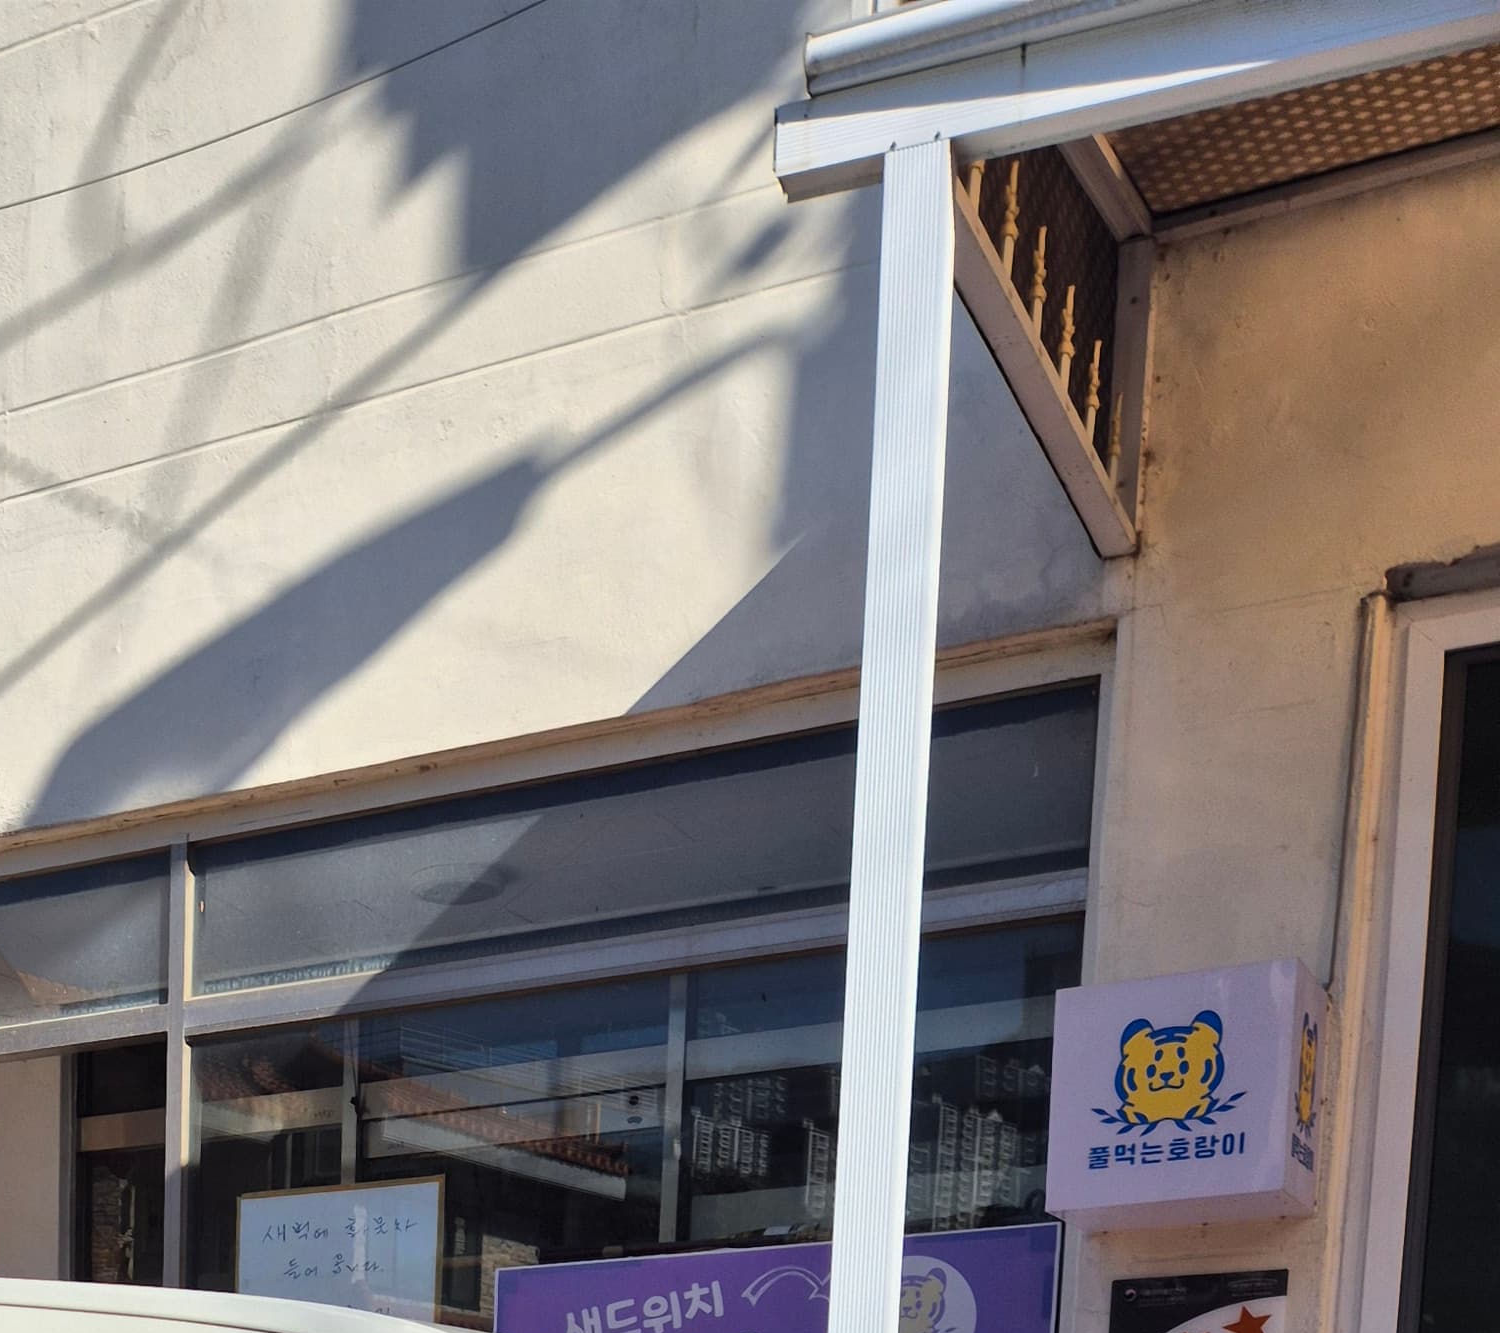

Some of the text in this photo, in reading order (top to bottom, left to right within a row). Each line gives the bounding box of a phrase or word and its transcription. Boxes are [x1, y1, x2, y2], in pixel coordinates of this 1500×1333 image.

[1088, 1132, 1245, 1170] 풀먹는호랑이
[262, 1221, 329, 1243] 새벽에
[284, 1258, 318, 1280] 들어
